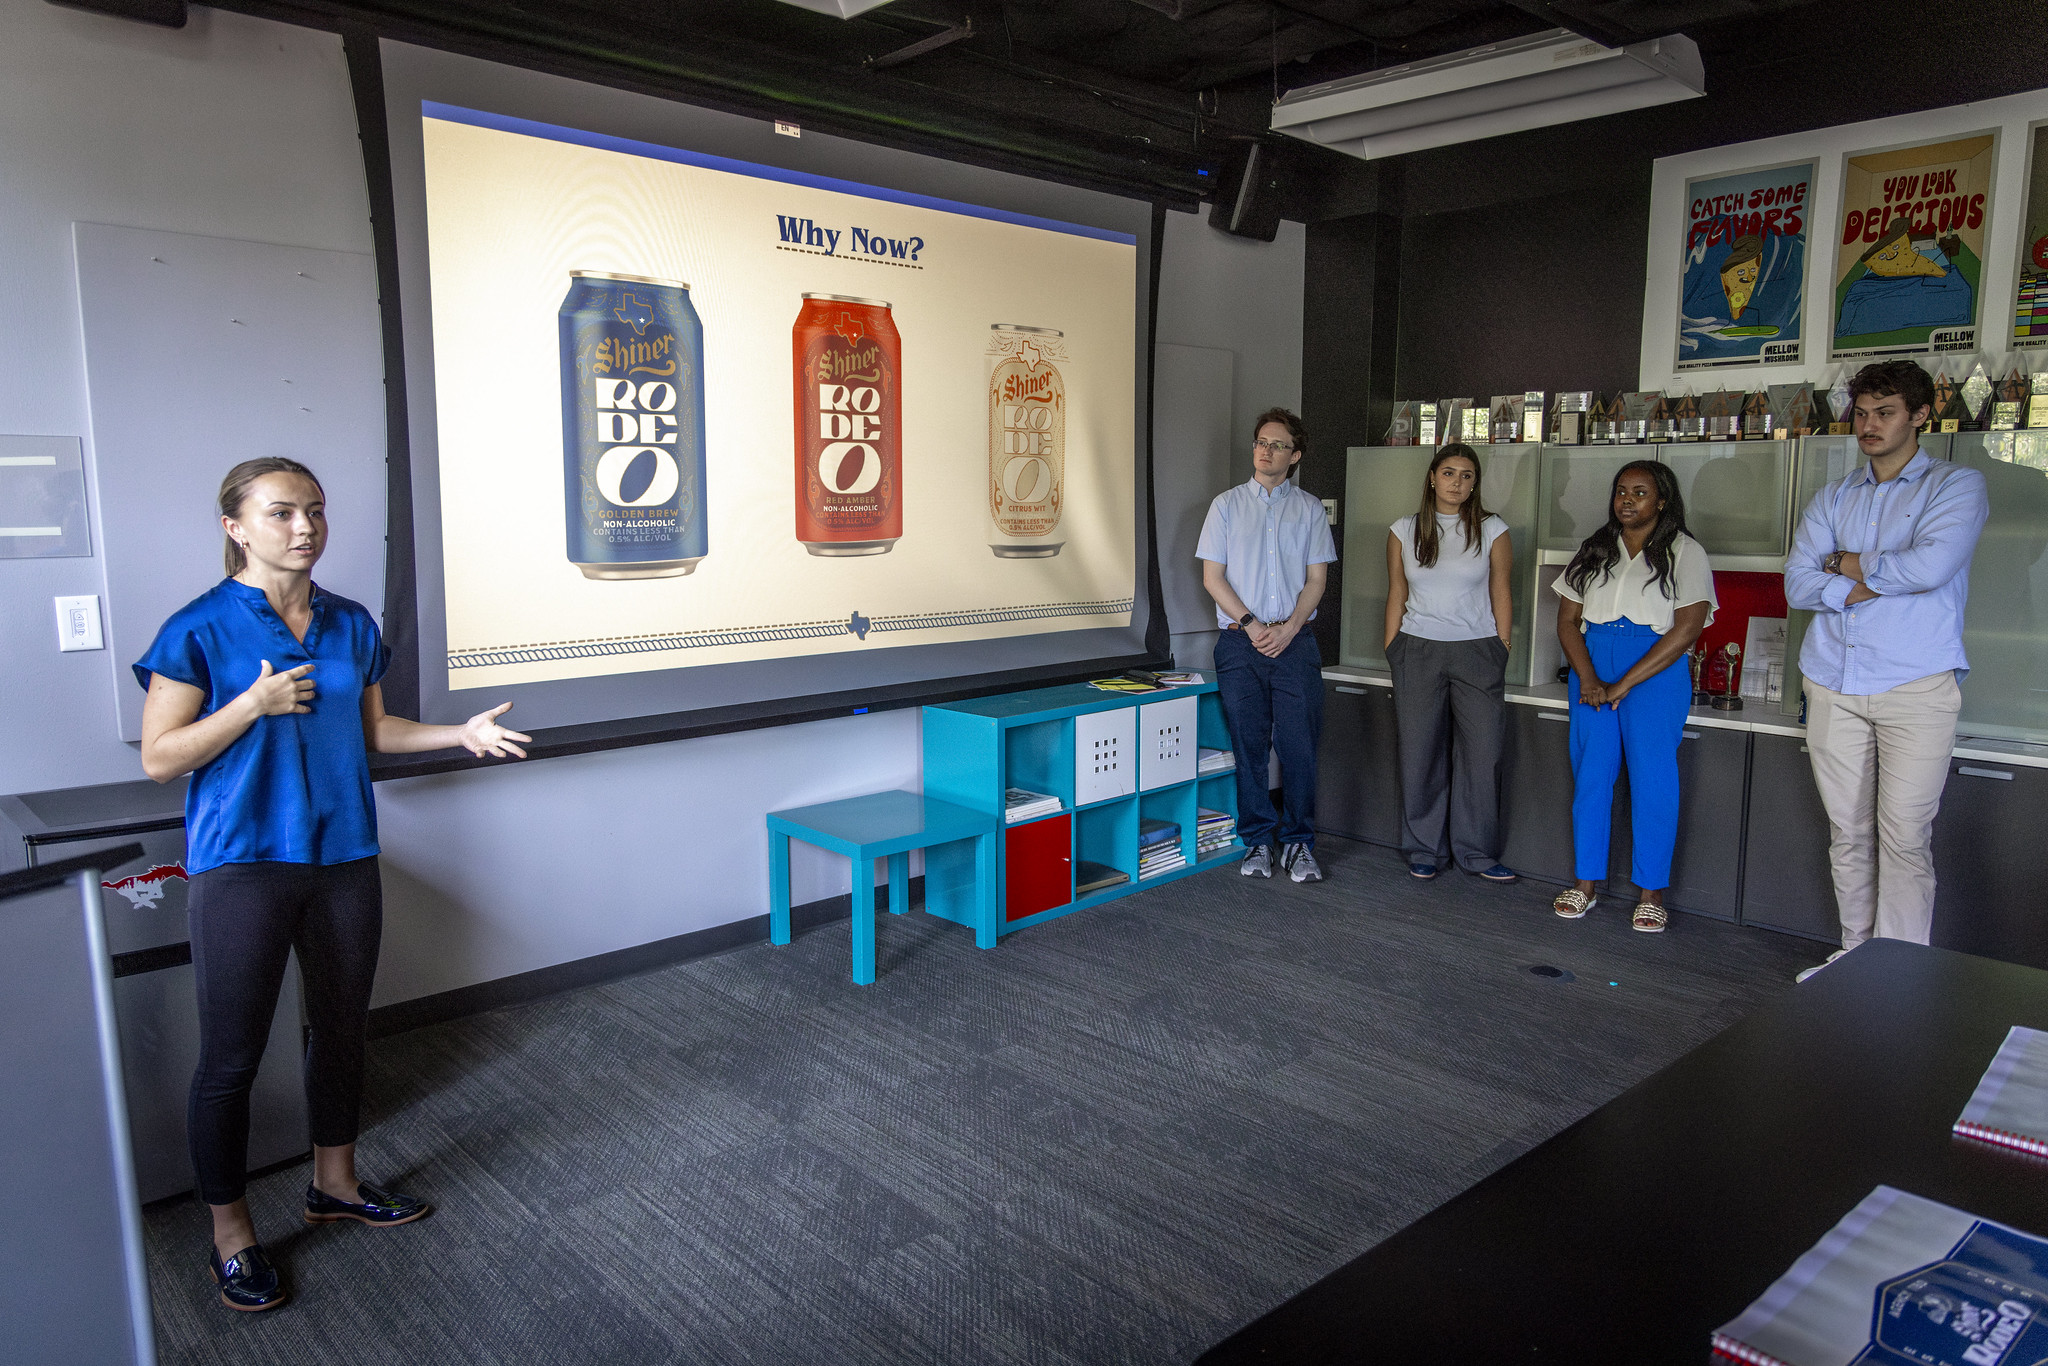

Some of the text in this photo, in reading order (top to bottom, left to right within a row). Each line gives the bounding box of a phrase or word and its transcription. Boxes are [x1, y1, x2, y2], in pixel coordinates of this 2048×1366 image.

[1883, 169, 1957, 204] YOU LOOK
[1690, 182, 1807, 220] CATCH SOME
[1843, 193, 1985, 245] DELICIOUS
[1688, 205, 1803, 250] FLAVORS
[776, 214, 924, 261] Why Now?
[1934, 331, 1974, 343] MELLOW
[1765, 343, 1799, 355] MELLOW
[1933, 341, 1974, 351] MUSHROOM
[592, 333, 676, 376] Shiner
[1764, 354, 1799, 363] MUSHROOM
[817, 346, 880, 382] Shiner
[1003, 371, 1053, 403] Shiner
[826, 496, 876, 504] RED AMBER
[598, 509, 679, 519] GOLDEN BREW
[823, 504, 878, 512] NON-ALCOHOLIC
[815, 511, 849, 519] CONTAINS
[603, 519, 676, 528] NON-ALCOHOLIC
[593, 525, 685, 536] CONTAINS LESS THAN
[608, 534, 671, 543] 0.5% ALC/VOL
